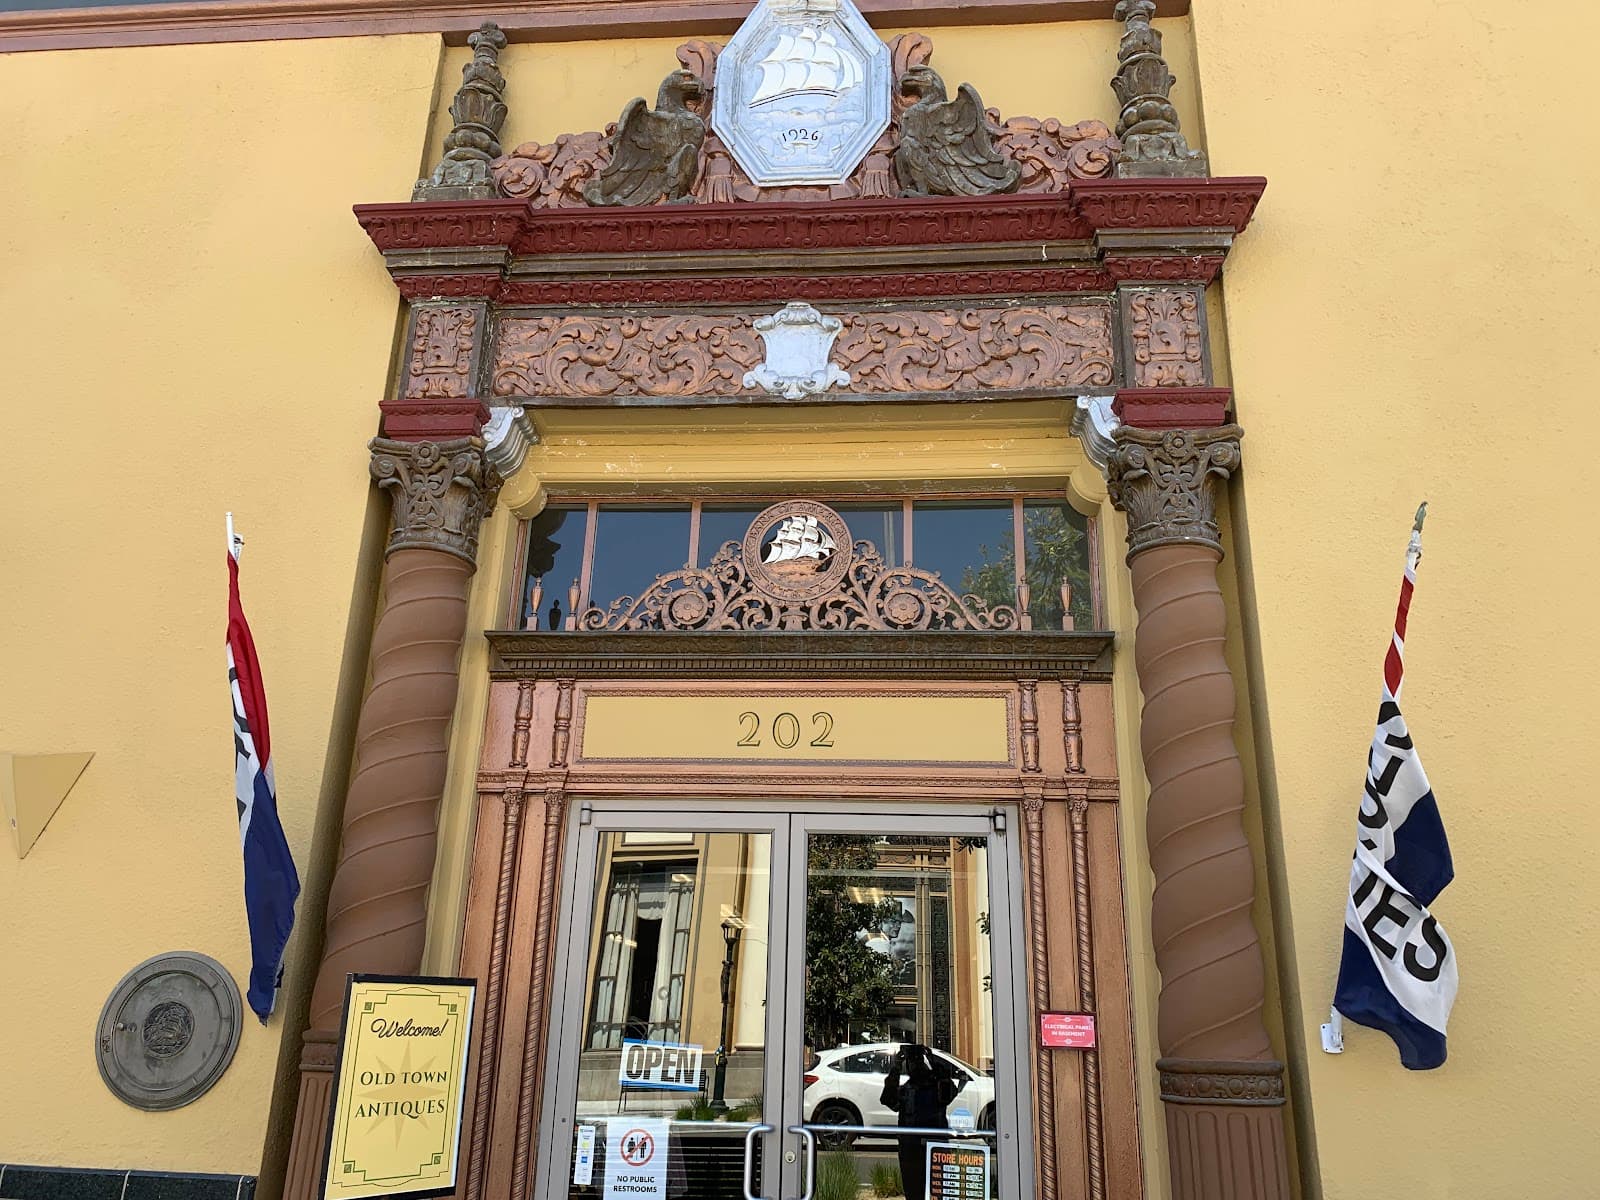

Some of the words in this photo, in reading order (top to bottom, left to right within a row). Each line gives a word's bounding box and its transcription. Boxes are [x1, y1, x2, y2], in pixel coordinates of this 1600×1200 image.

[782, 128, 819, 142] 1926
[737, 711, 834, 749] 202
[370, 1018, 449, 1038] Welcome!
[626, 1045, 696, 1084] OPEN
[360, 1071, 395, 1086] OLD
[402, 1071, 447, 1085] TOWN
[355, 1099, 445, 1119] ANTIQUES
[932, 1152, 956, 1164] STORE
[958, 1154, 984, 1166] HOURS
